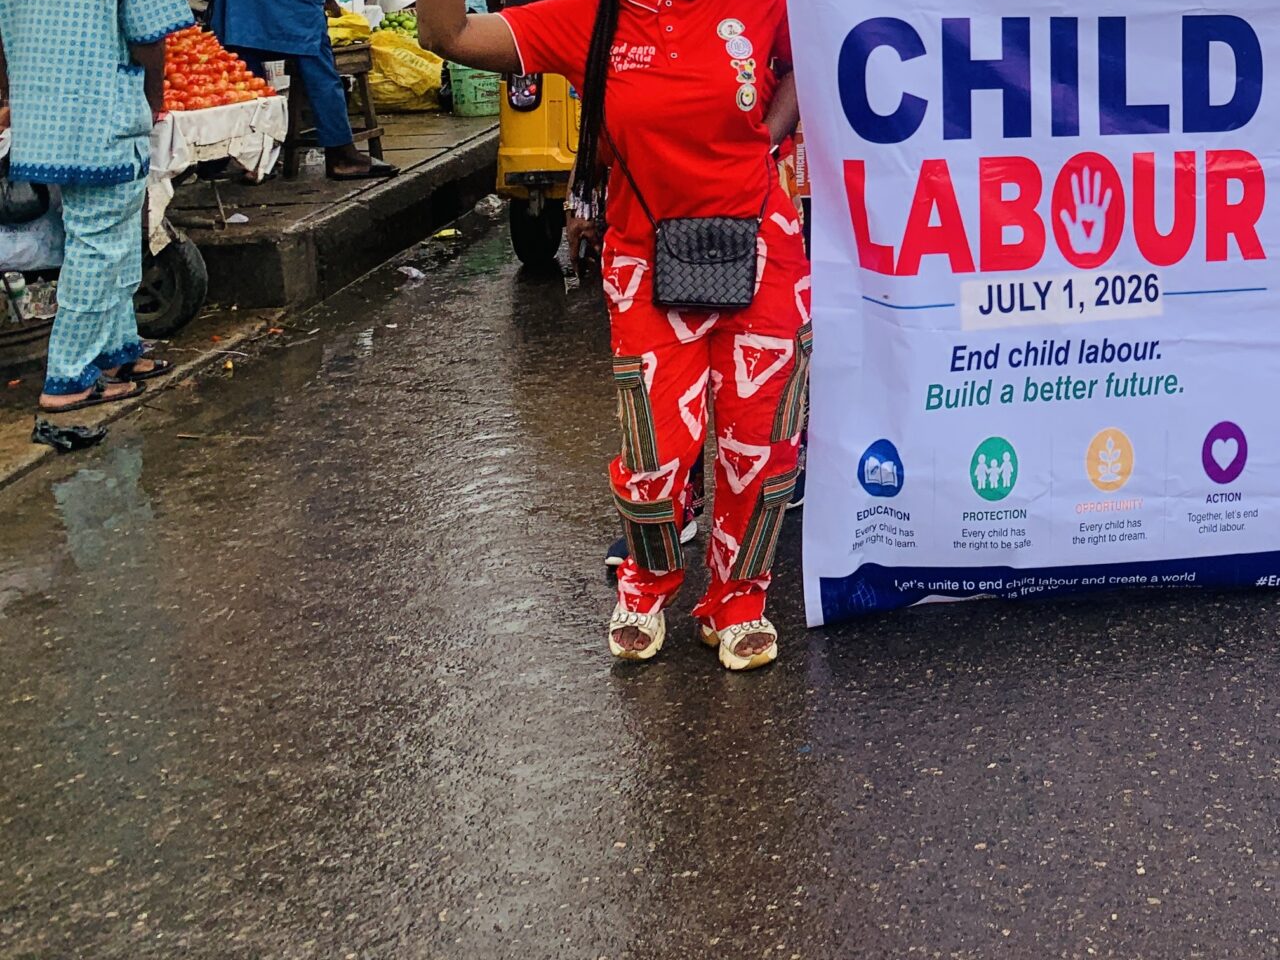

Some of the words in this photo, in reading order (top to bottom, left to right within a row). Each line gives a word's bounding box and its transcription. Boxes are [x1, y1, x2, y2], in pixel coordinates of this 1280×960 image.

[838, 14, 1264, 144] CHILD
[842, 149, 1267, 276] LABOUR
[979, 280, 1053, 315] JULY
[1063, 278, 1085, 314] 1,
[1094, 273, 1160, 307] 2026
[950, 343, 1000, 373] End
[1008, 340, 1071, 368] child
[1078, 338, 1162, 364] labour.
[925, 380, 993, 411] Build
[1000, 383, 1014, 404] a
[1023, 375, 1098, 403] better
[1105, 372, 1184, 398] future.
[1205, 492, 1242, 504] ACTION
[857, 505, 911, 521] EDUCATION
[1075, 498, 1144, 515] OPPORTUNITY
[962, 509, 1027, 521] PROTECTION
[1187, 511, 1224, 524] Together,
[1225, 510, 1242, 521] let's
[1243, 509, 1259, 519] end
[855, 522, 877, 539] Every
[879, 523, 897, 537] child
[899, 527, 915, 537] has
[961, 528, 985, 540] Every
[987, 528, 1008, 538] child
[1010, 527, 1026, 537] has
[1079, 522, 1102, 534] Every
[1104, 520, 1125, 531] child
[1126, 519, 1142, 529] has
[1198, 524, 1218, 534] child
[1219, 522, 1246, 533] labour.
[852, 540, 864, 551] the
[865, 534, 884, 544] right
[886, 536, 893, 546] to
[894, 539, 918, 548] learn.
[953, 540, 967, 549] the
[968, 540, 988, 551] right
[990, 541, 999, 549] to
[1000, 540, 1012, 549] be
[1013, 539, 1034, 549] safe.
[1072, 535, 1086, 545] the
[1087, 534, 1107, 546] right
[1108, 534, 1117, 543] to
[1119, 531, 1148, 542] dream.
[928, 579, 959, 590] unite
[962, 579, 975, 590] to
[978, 578, 1002, 590] end
[1006, 576, 1035, 589] child
[1038, 577, 1079, 586] labour
[1081, 575, 1106, 585] and
[1109, 574, 1147, 584] create
[1150, 575, 1159, 583] a
[1161, 572, 1196, 582] world
